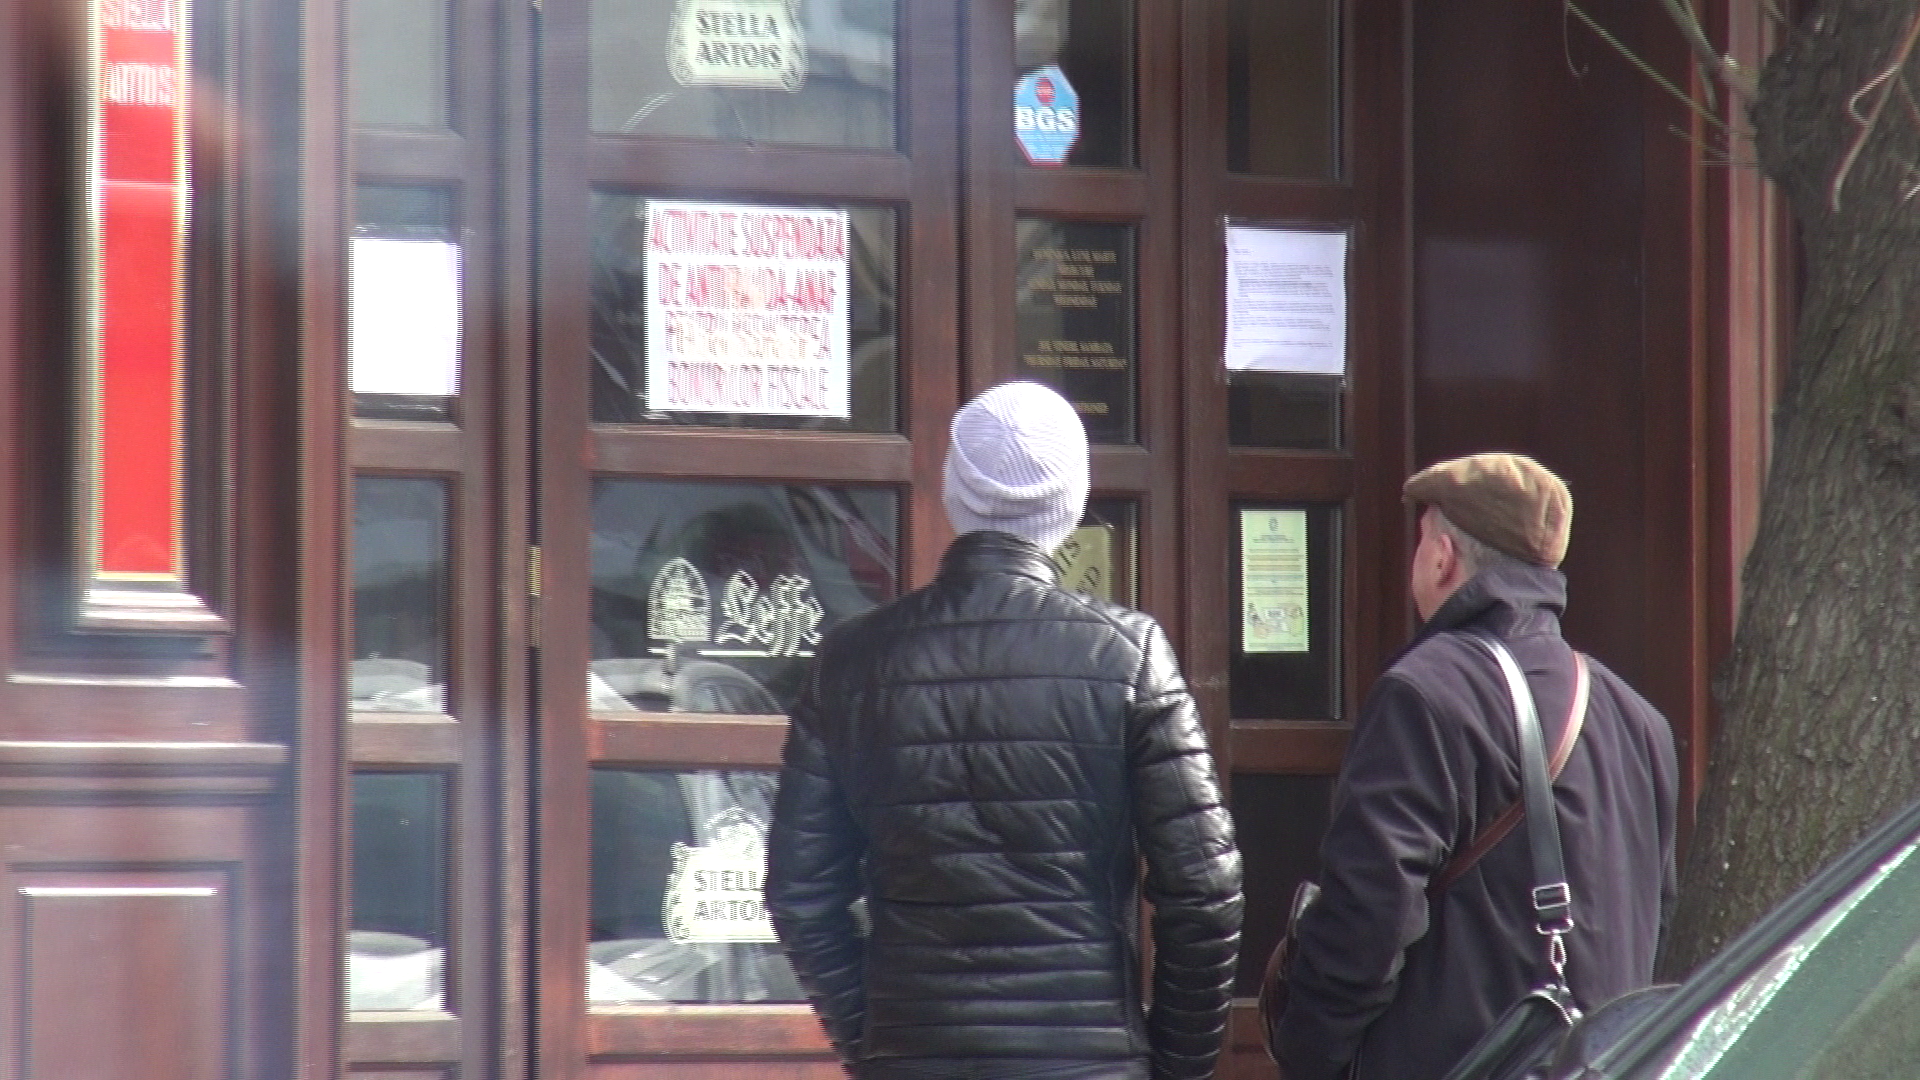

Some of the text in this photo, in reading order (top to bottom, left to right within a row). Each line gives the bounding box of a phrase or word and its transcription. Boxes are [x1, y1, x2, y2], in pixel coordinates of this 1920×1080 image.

[104, 0, 176, 32] STELLA
[696, 8, 782, 40] STELLA
[695, 40, 783, 70] ARTOIS
[104, 62, 176, 107] ARTOIS
[1015, 105, 1078, 134] BGS
[648, 209, 738, 257] ACTIVITATE
[659, 262, 682, 307] DE
[768, 366, 830, 411] FISCALE
[716, 569, 825, 657] Leffe
[694, 869, 765, 892] STELL
[693, 899, 768, 922] ARTOI
